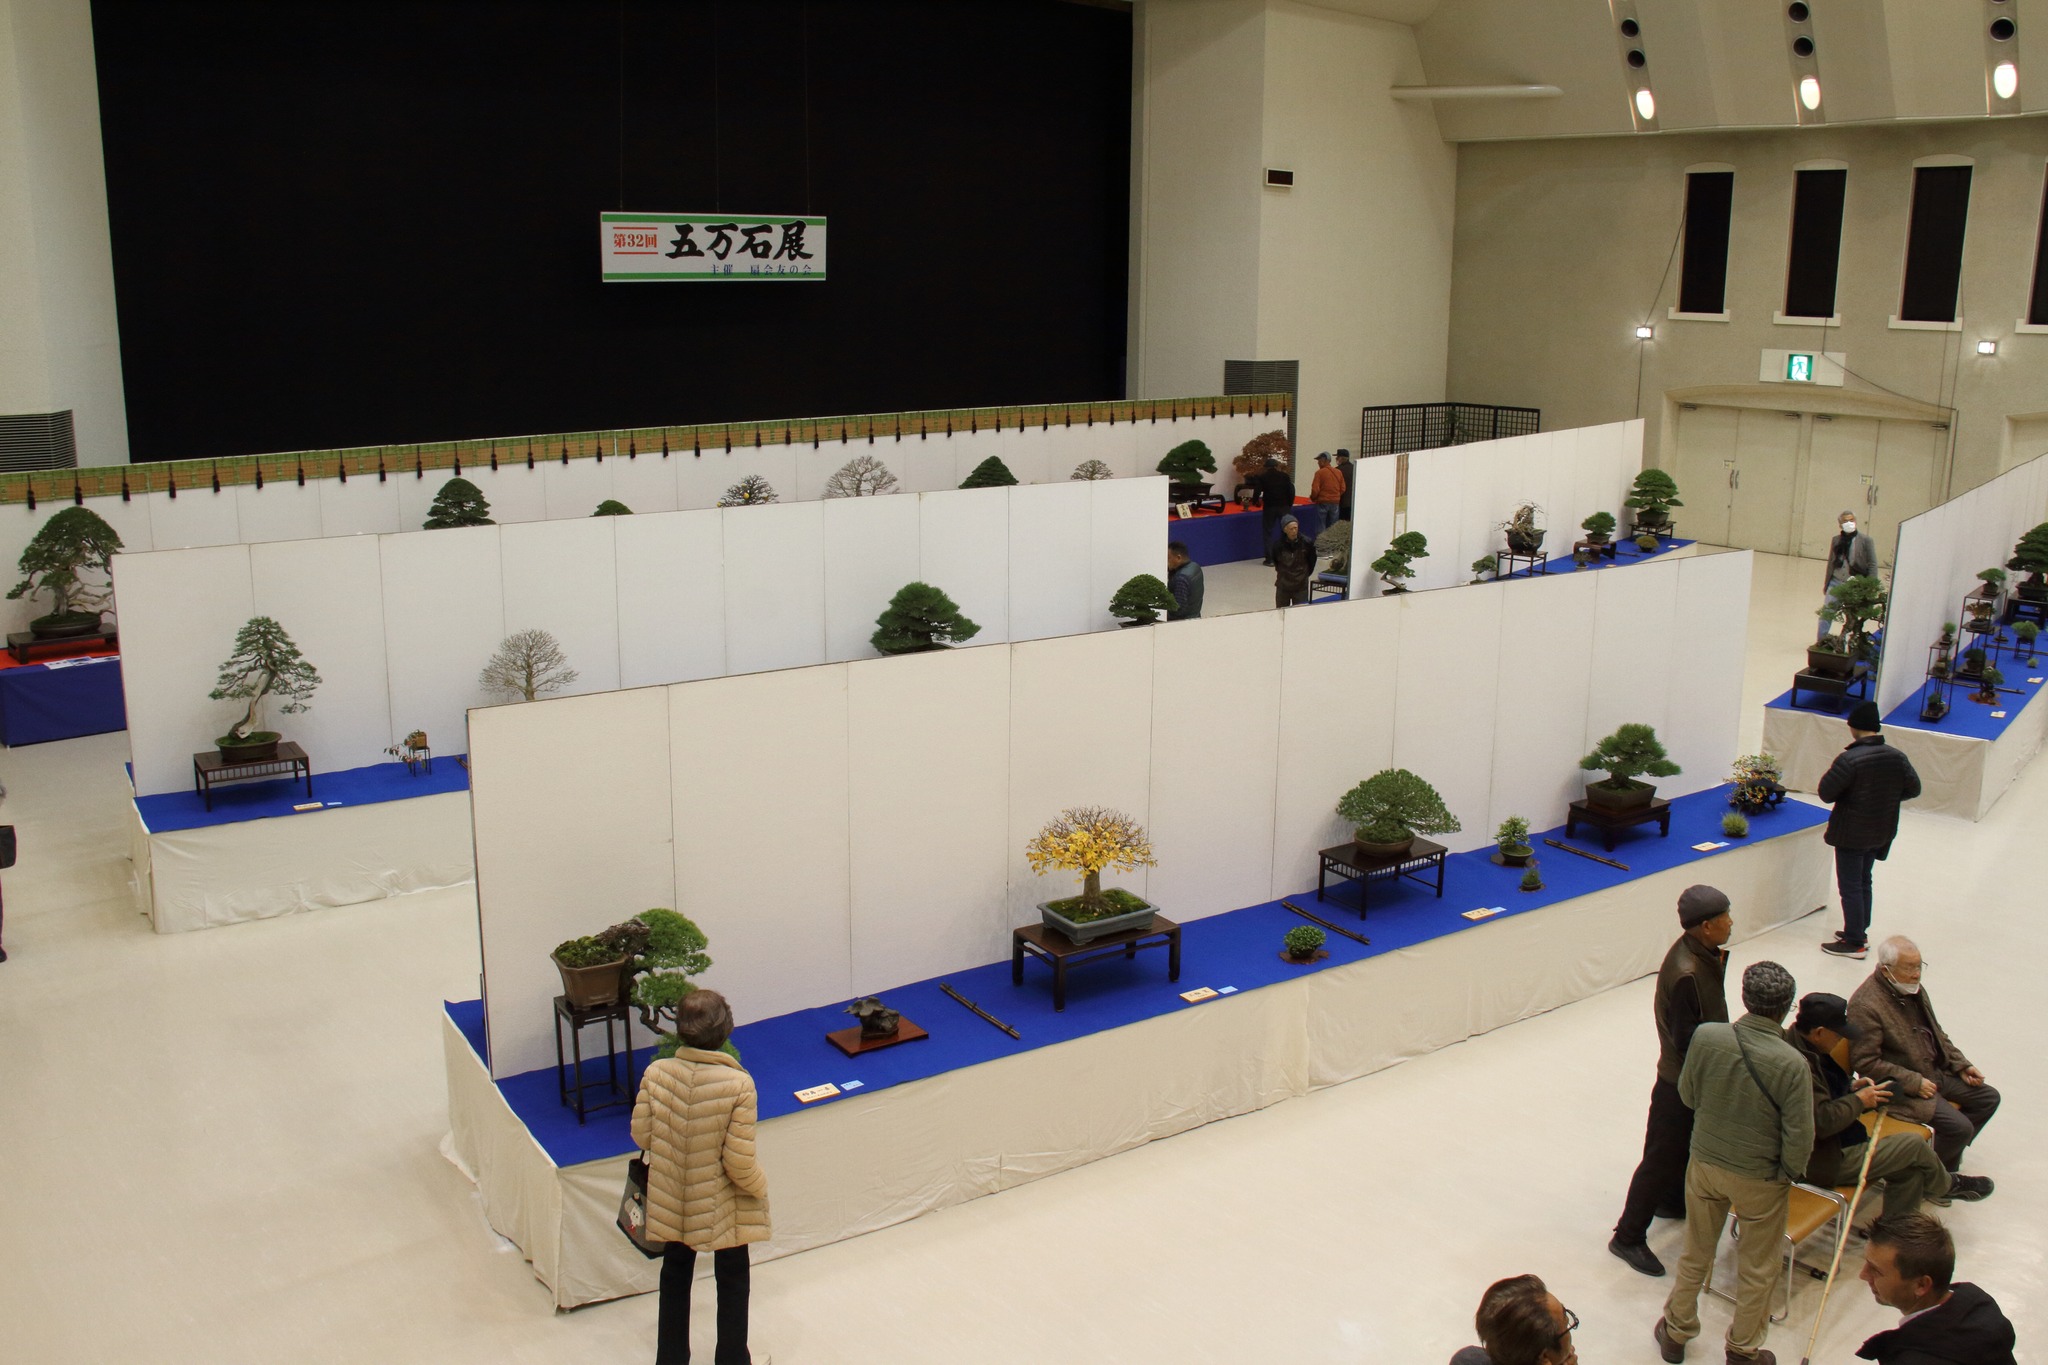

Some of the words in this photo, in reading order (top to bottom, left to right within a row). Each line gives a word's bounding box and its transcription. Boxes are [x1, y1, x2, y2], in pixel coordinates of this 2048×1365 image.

[613, 233, 657, 248] 第32回
[665, 220, 814, 261] 五万石展
[711, 264, 733, 276] 主催
